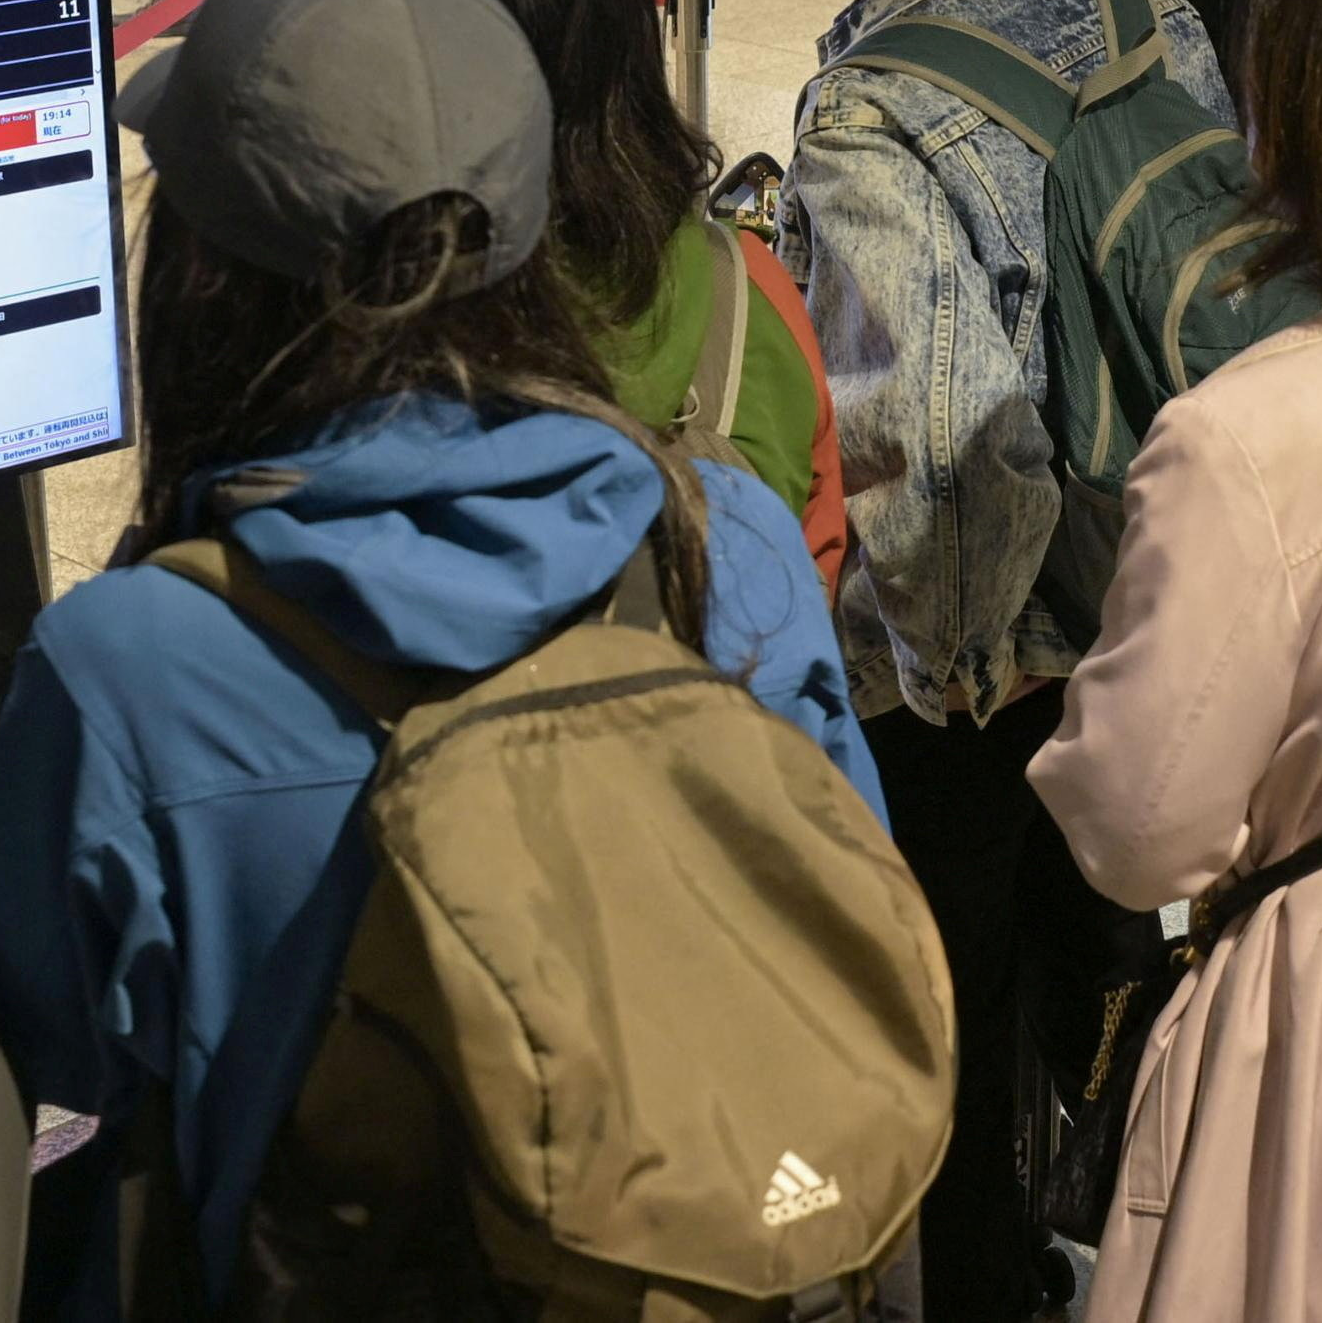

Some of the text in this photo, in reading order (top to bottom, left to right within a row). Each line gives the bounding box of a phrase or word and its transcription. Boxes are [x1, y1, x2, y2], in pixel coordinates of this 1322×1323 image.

[43, 109, 72, 121] 19:14
[43, 126, 62, 137] 現在
[761, 1174, 841, 1226] adidas
